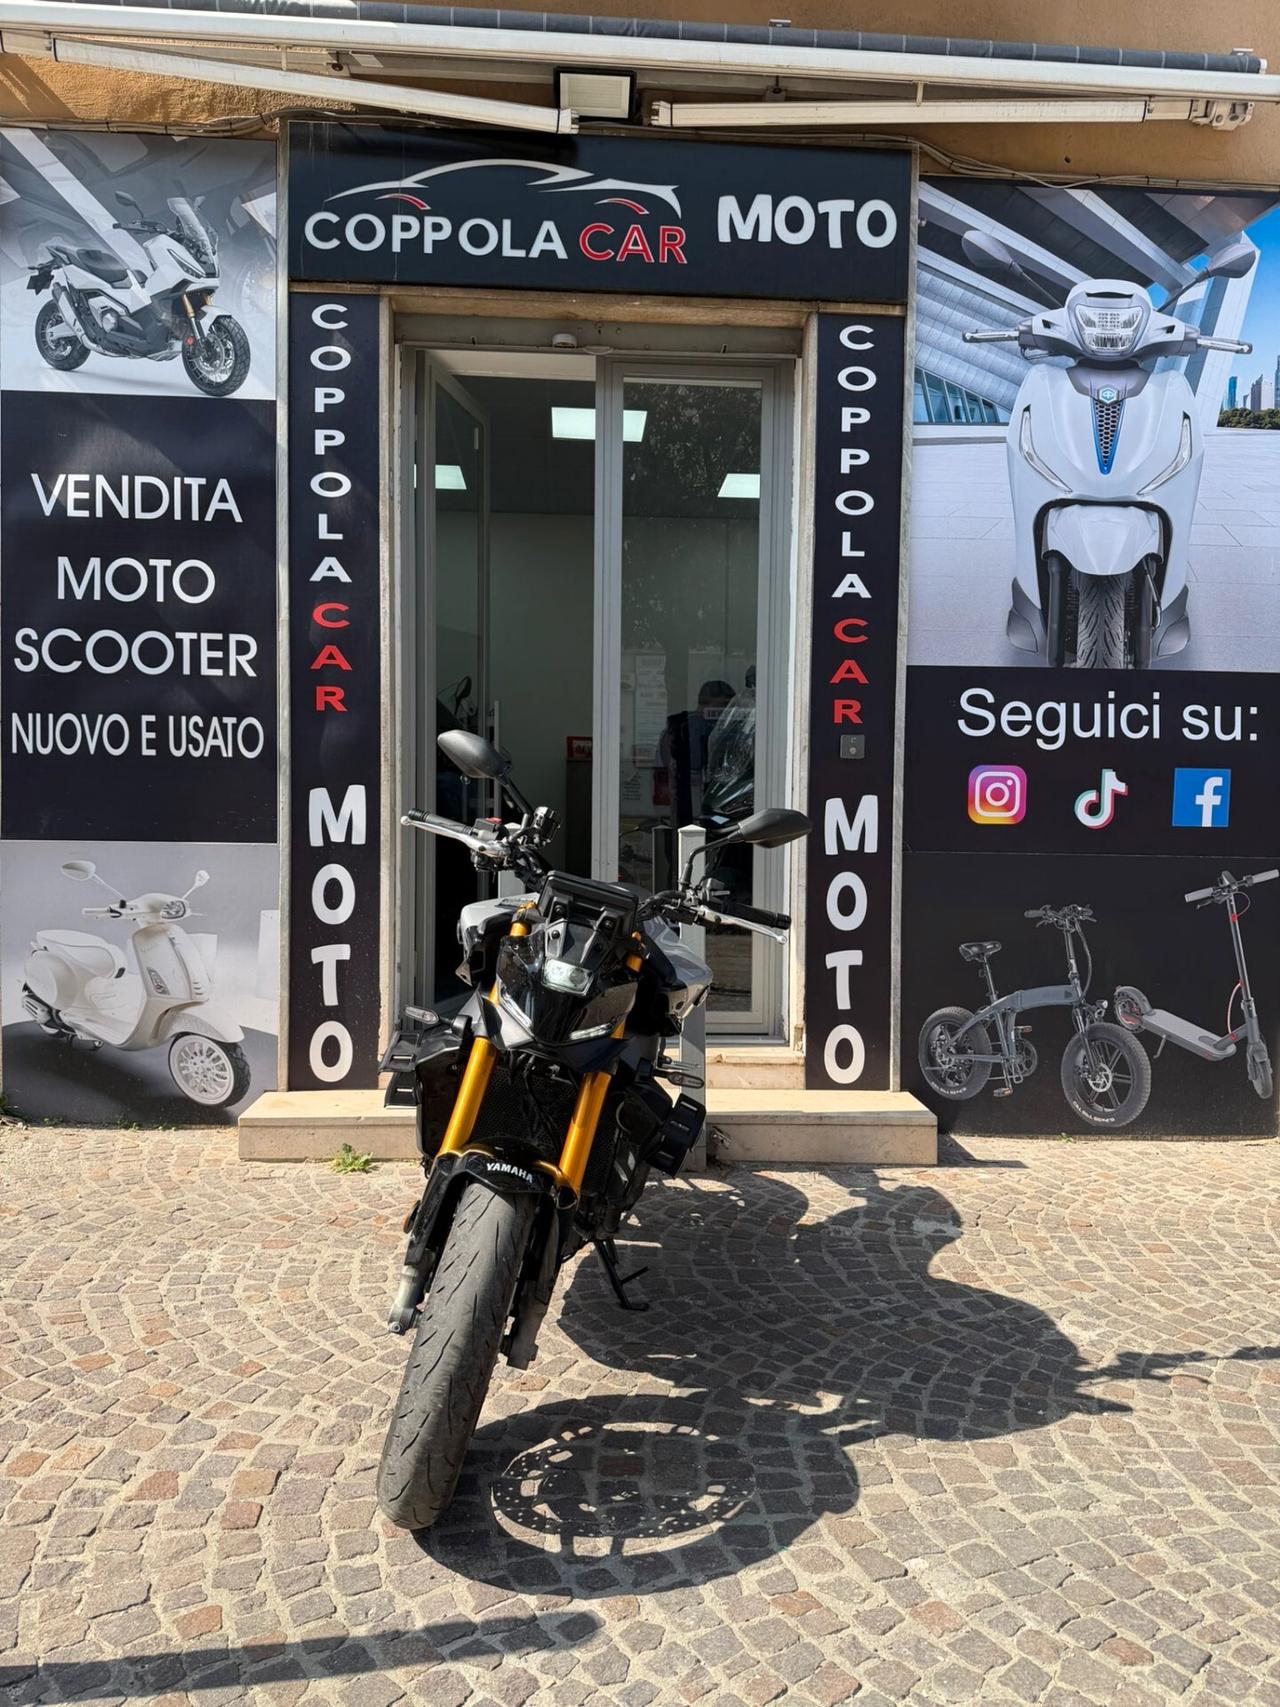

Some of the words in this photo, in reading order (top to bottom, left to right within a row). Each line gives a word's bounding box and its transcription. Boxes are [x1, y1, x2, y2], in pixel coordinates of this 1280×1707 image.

[304, 211, 568, 260] COPPOLA
[579, 223, 688, 265] CAR
[717, 194, 897, 249] MOTO
[310, 303, 352, 583] COPPOLA
[831, 325, 877, 598] COPPOLA
[30, 473, 243, 523] VENDITA
[57, 556, 216, 604] MOTO
[14, 628, 258, 677] SCOOTER
[310, 603, 352, 712] CAR
[830, 618, 869, 724] CAR
[11, 712, 130, 756] NUOVO
[141, 715, 157, 756] E
[168, 715, 264, 759] USATO
[957, 687, 1161, 751] Seguici
[1182, 702, 1258, 742] su:
[309, 784, 366, 1083] MOTO
[824, 795, 878, 1084] MOTO
[486, 1162, 533, 1184] YAMAHA
